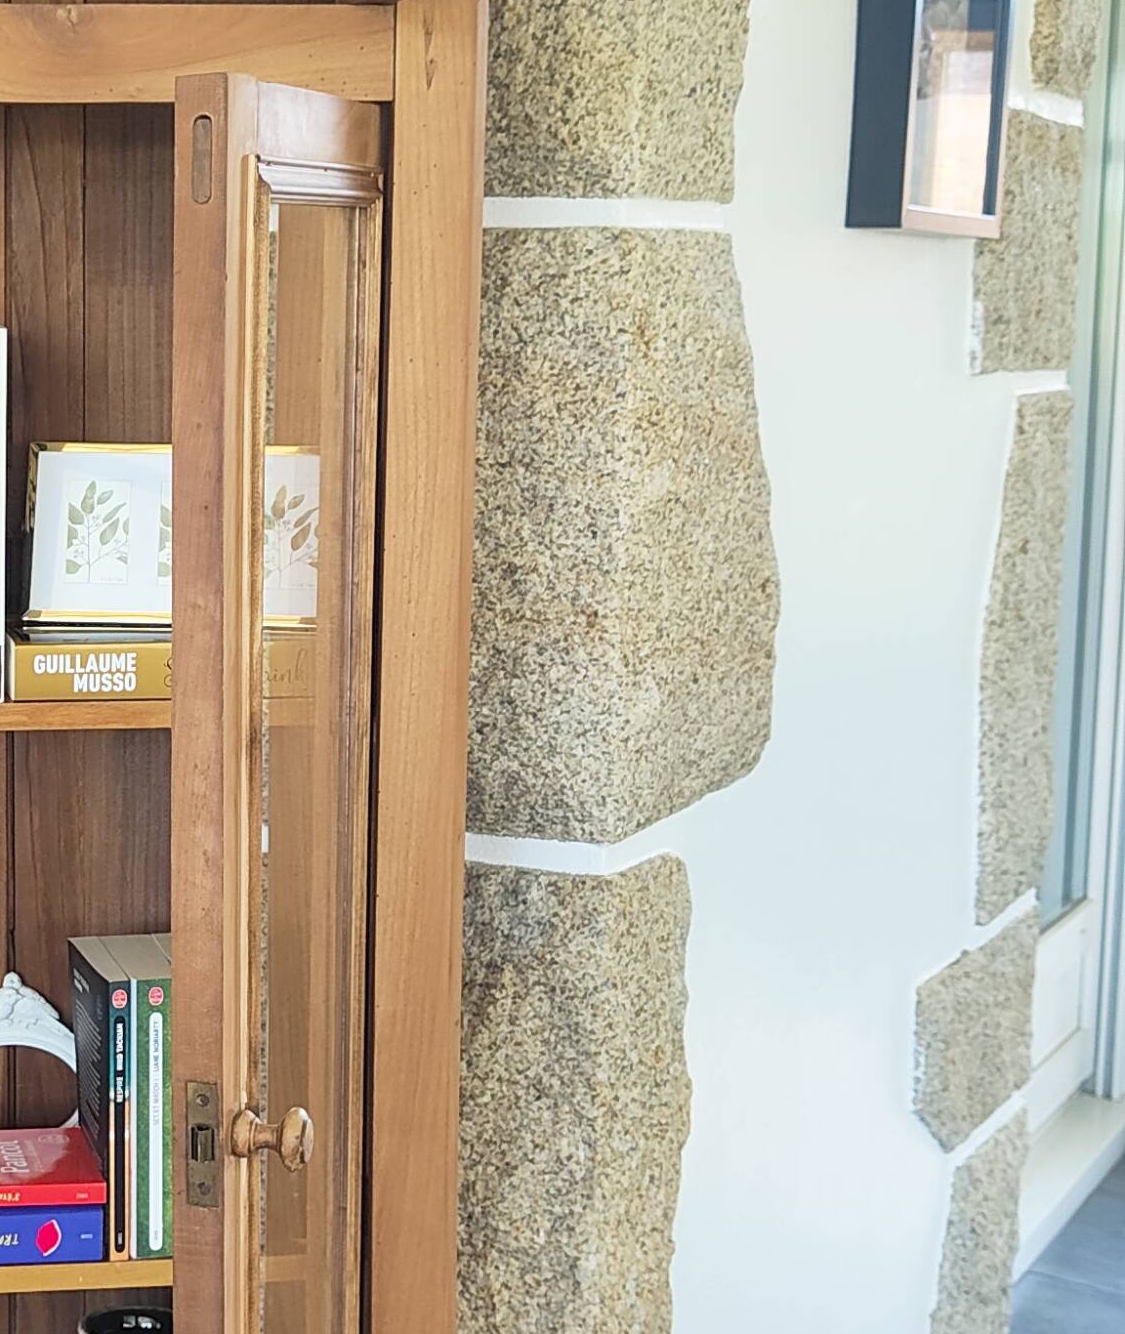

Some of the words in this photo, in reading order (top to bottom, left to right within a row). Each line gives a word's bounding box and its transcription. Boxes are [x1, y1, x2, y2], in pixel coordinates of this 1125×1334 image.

[33, 652, 137, 674] GUILLAUME
[73, 672, 137, 693] MUSSO
[0, 1140, 30, 1173] Pancol
